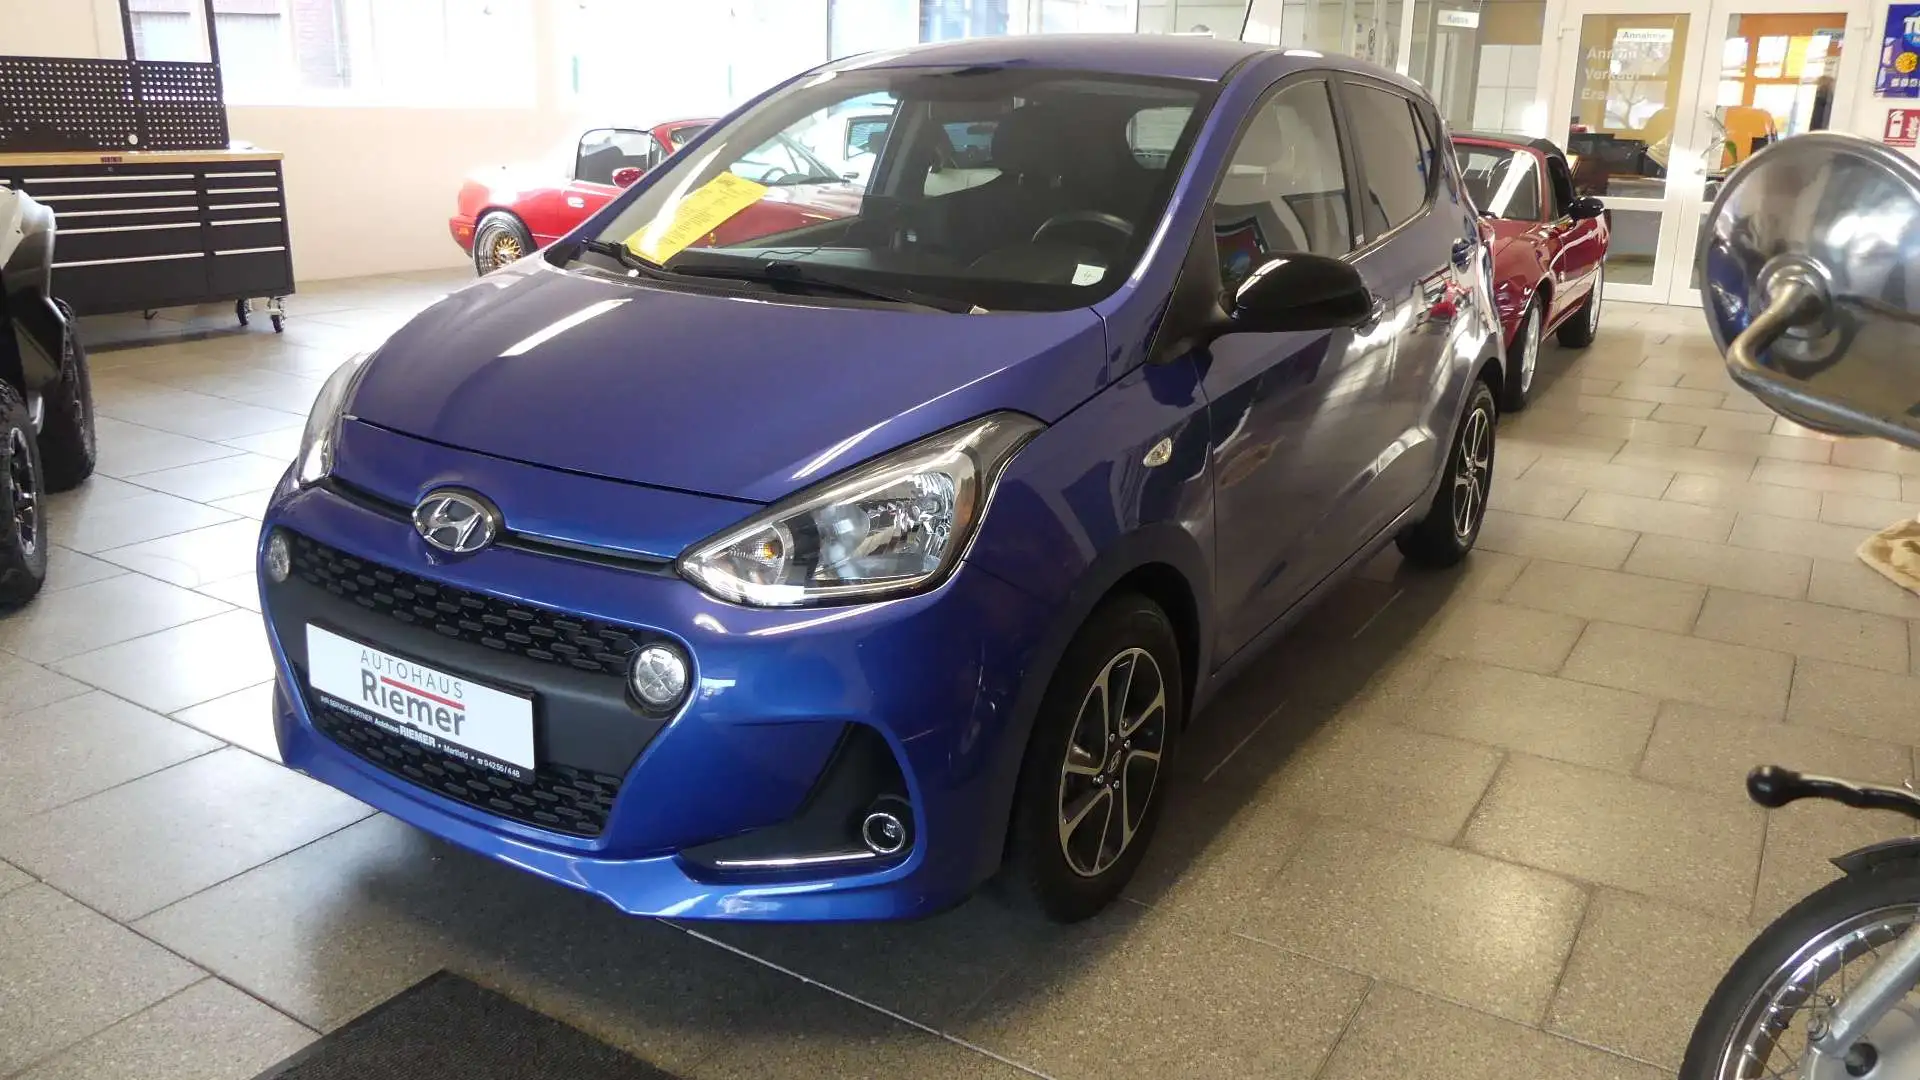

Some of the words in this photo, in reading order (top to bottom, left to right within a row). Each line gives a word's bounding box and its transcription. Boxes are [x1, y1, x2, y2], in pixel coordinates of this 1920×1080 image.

[361, 650, 463, 698] AUTOHAUS
[361, 669, 465, 736] Riemer
[400, 725, 436, 748] RIEMER
